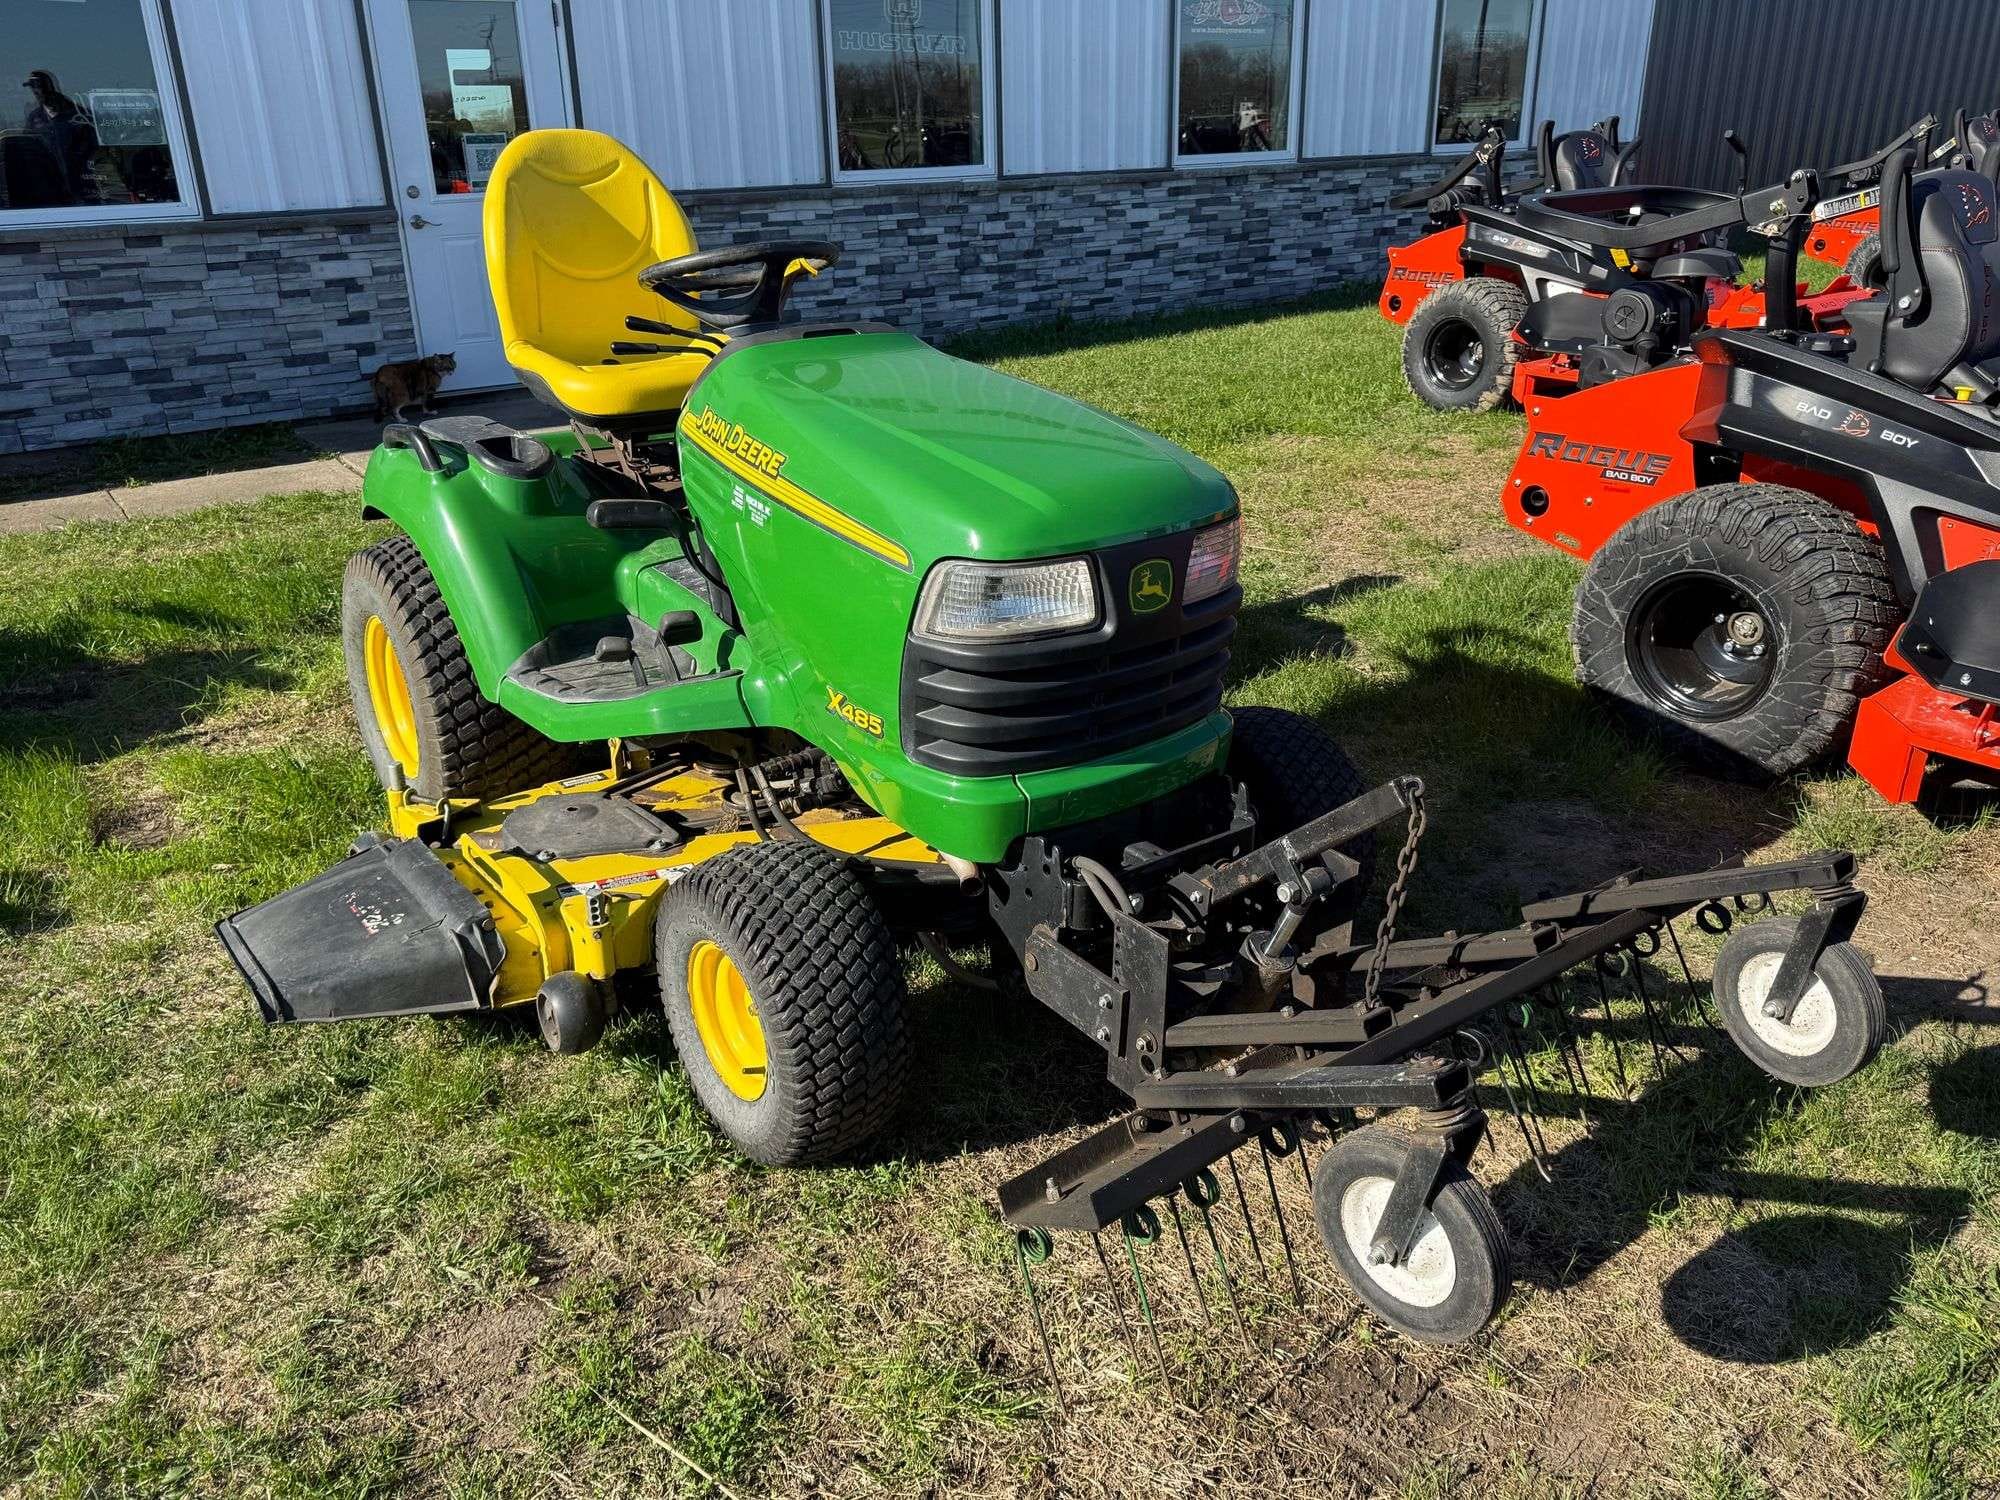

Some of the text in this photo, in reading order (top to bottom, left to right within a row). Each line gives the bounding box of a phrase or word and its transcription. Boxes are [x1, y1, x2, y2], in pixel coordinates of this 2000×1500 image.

[838, 30, 966, 55] HUSTLER
[697, 404, 787, 480] JOHN DEERE
[1796, 402, 1919, 448] BAD BOY
[1527, 431, 1673, 476] ROGUE
[1605, 470, 1654, 484] BAD BOY
[825, 685, 885, 739] X485
